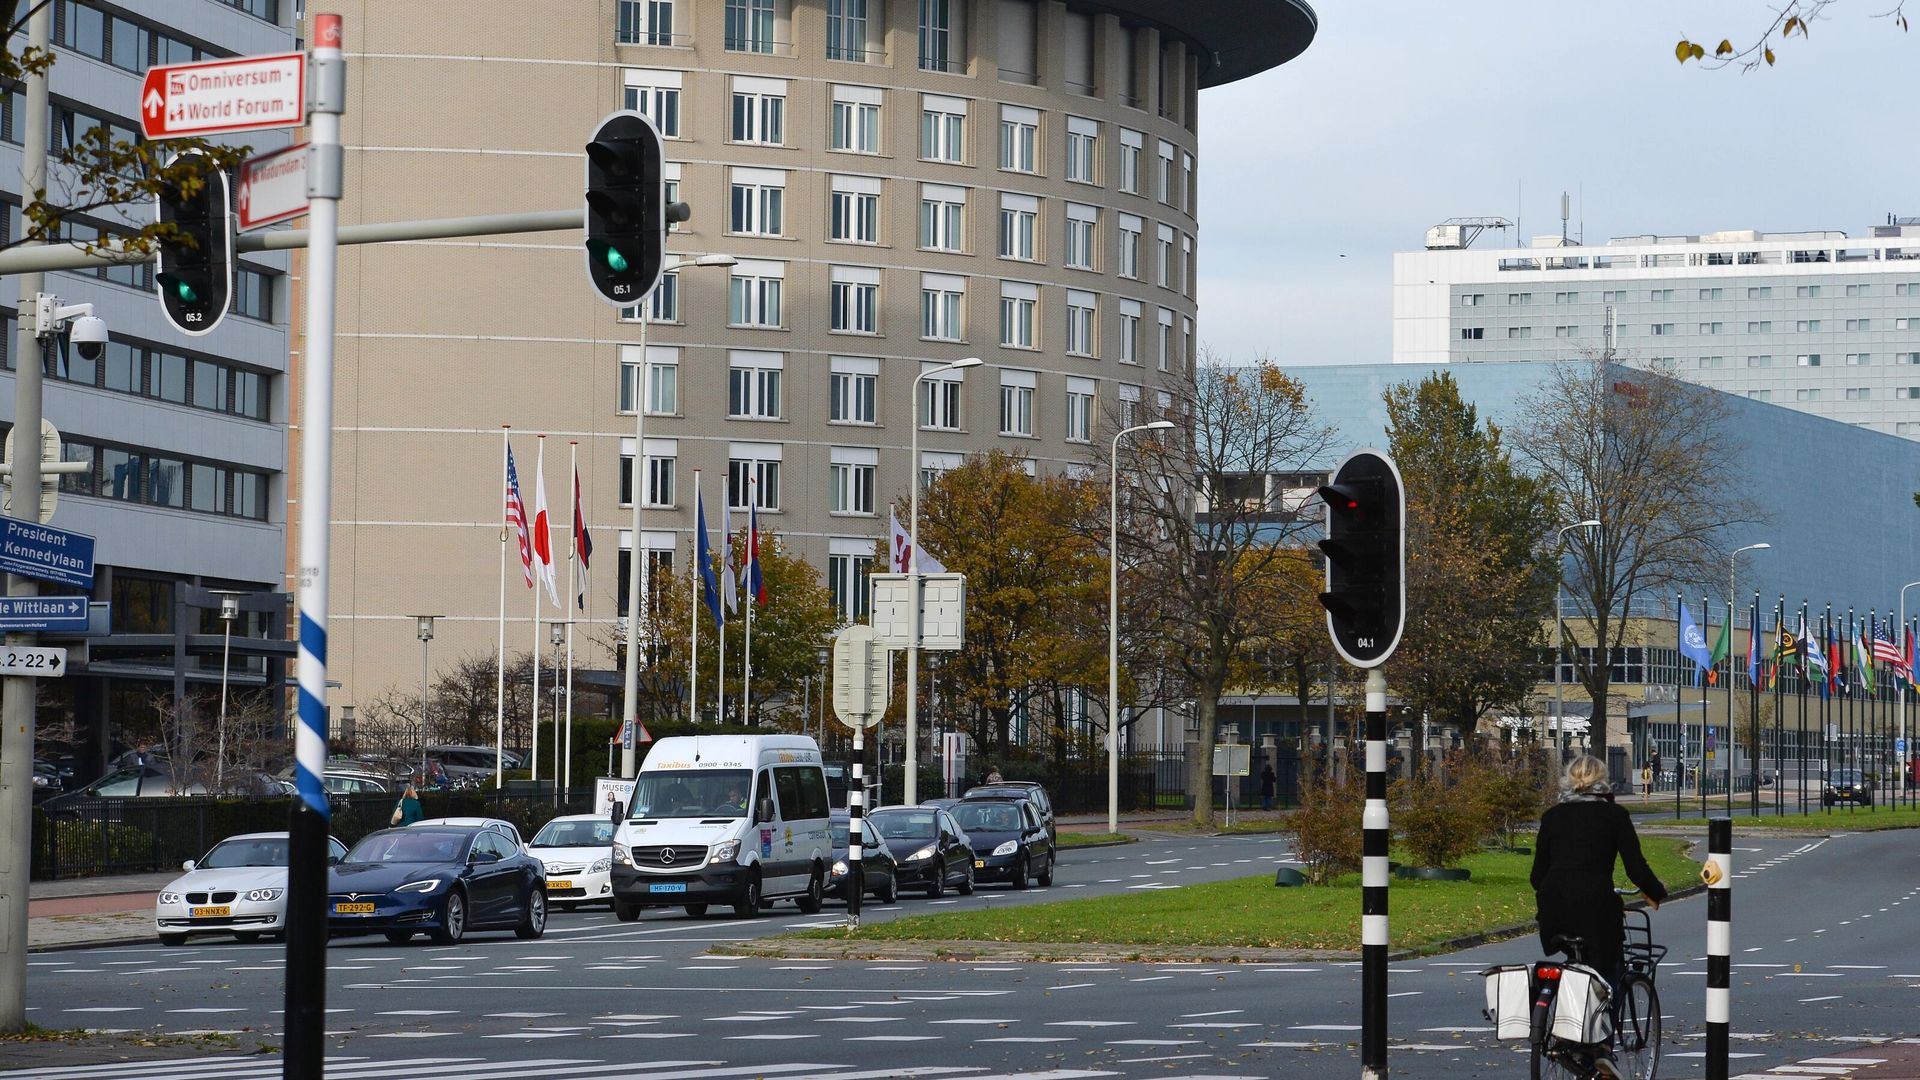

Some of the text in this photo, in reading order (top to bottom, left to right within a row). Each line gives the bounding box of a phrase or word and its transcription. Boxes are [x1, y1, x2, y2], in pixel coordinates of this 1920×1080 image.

[188, 69, 282, 91] Omniversum
[188, 100, 231, 120] World
[237, 98, 284, 115] Forum
[614, 285, 631, 295] 05.1
[186, 313, 202, 322] 05.2
[8, 522, 67, 547] President
[4, 540, 84, 570] Kennedylaan
[13, 601, 65, 614] Wittlaan
[1357, 637, 1374, 648] 04.1
[656, 761, 693, 769] Taxibus
[194, 907, 228, 916] 03-NNX-6
[338, 904, 372, 912] TF-292-G
